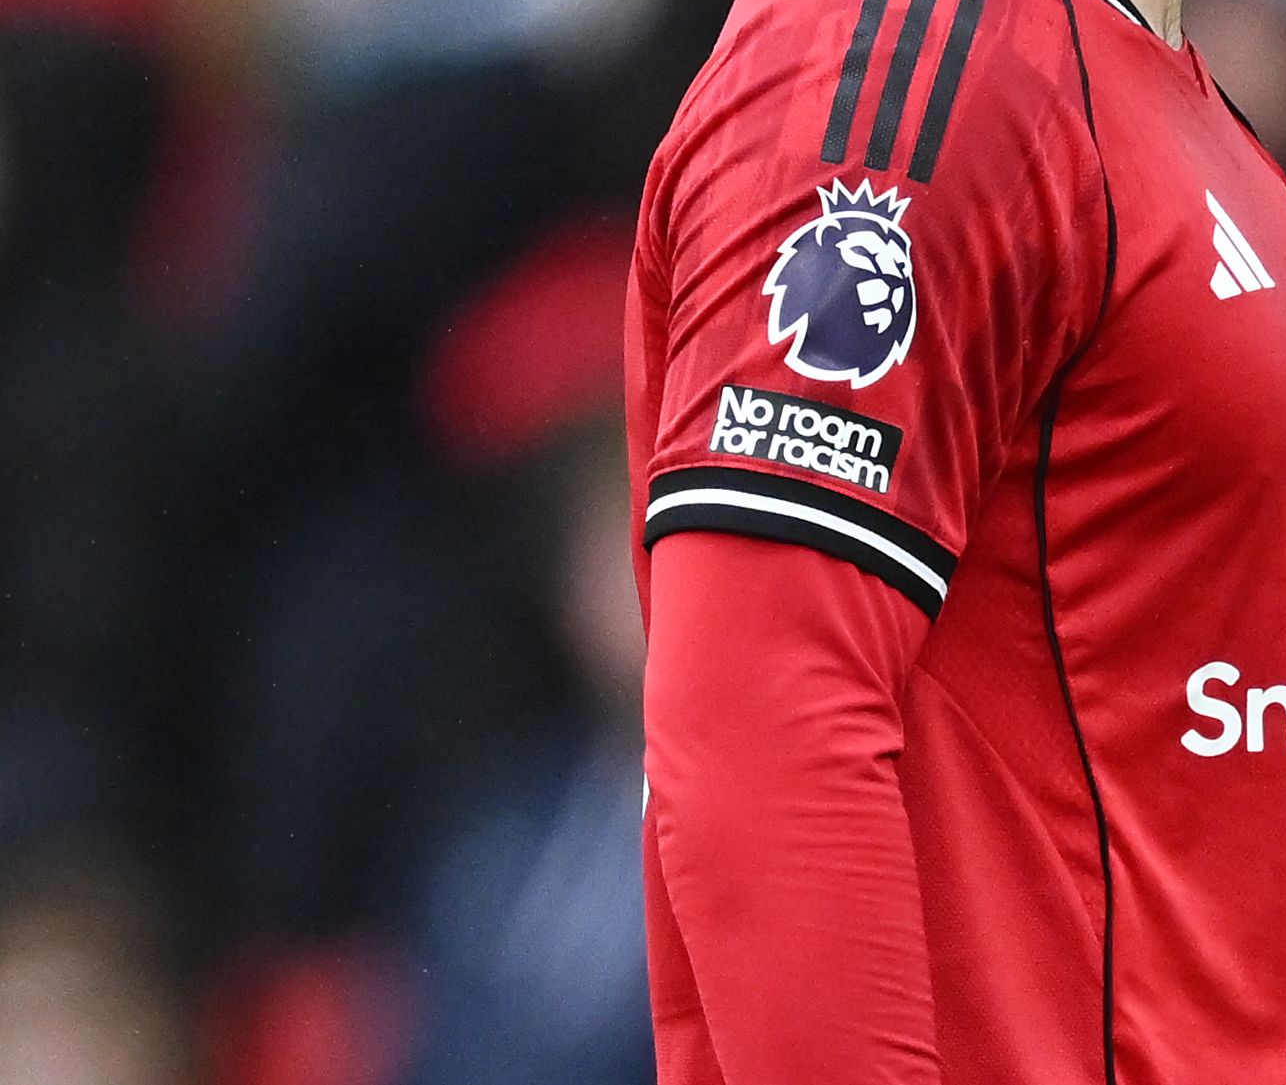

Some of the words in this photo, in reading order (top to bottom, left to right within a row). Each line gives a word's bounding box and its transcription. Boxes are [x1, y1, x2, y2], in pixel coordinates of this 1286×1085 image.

[709, 418, 767, 455] for
[767, 433, 889, 493] racism
[717, 386, 774, 426] No
[778, 403, 882, 458] room
